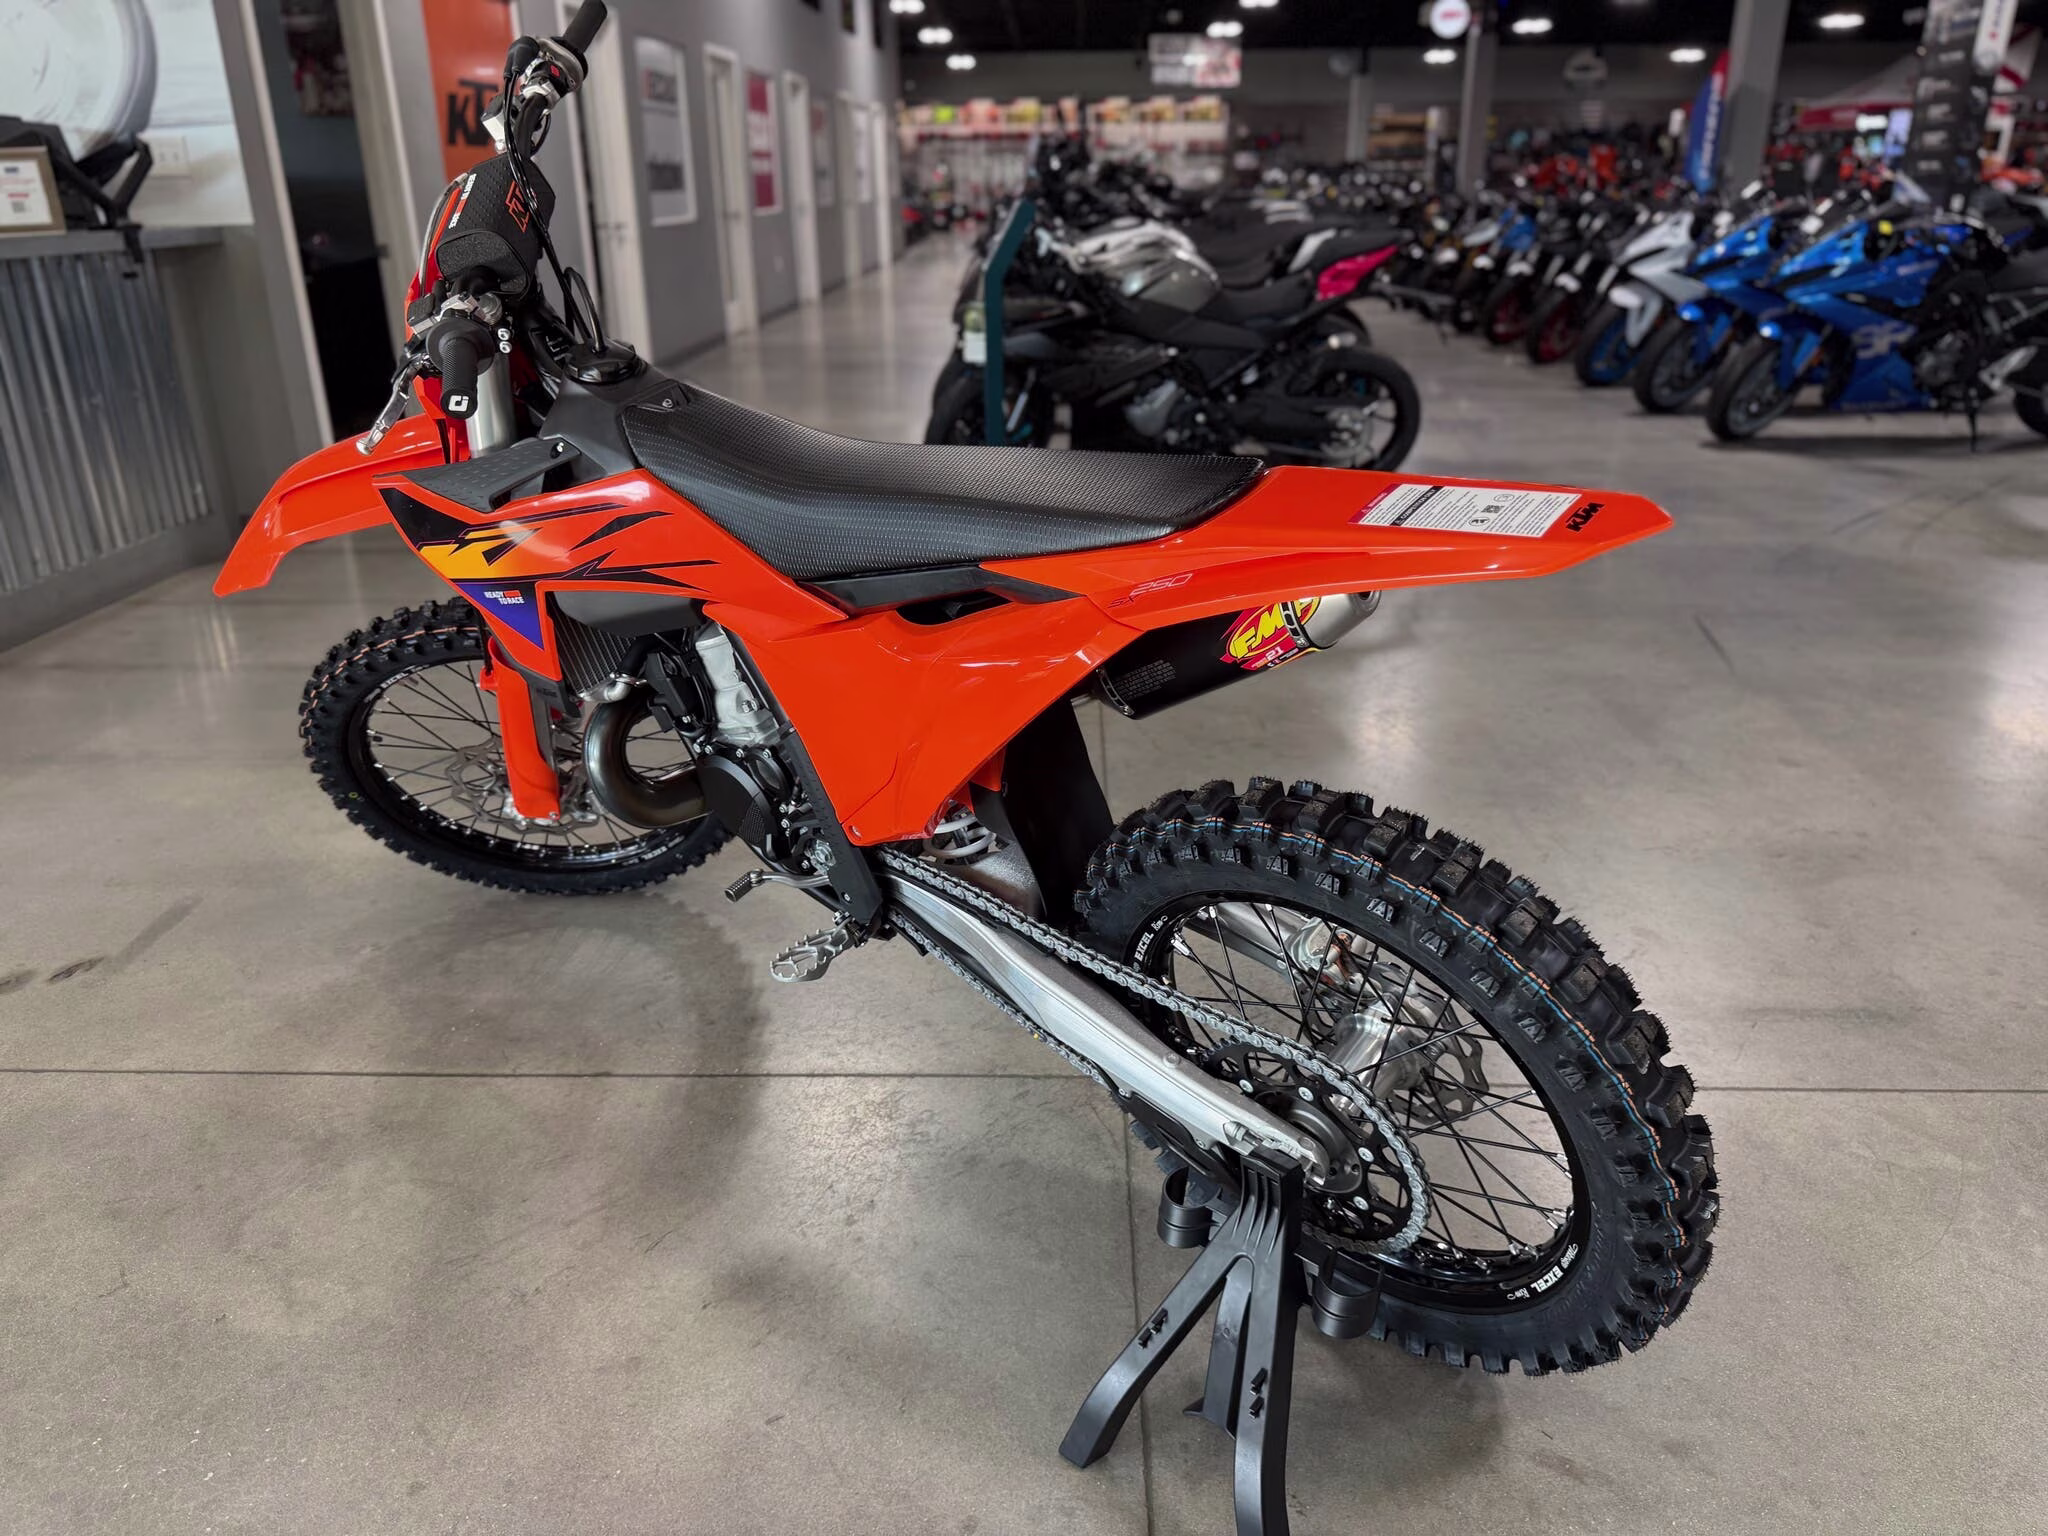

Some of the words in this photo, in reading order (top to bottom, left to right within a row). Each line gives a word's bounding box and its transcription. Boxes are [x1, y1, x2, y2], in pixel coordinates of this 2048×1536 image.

[1566, 502, 1605, 532] KTM
[1129, 573, 1193, 597] 250
[1134, 931, 1155, 961] EXCEL
[1530, 1265, 1564, 1293] EXCEL
